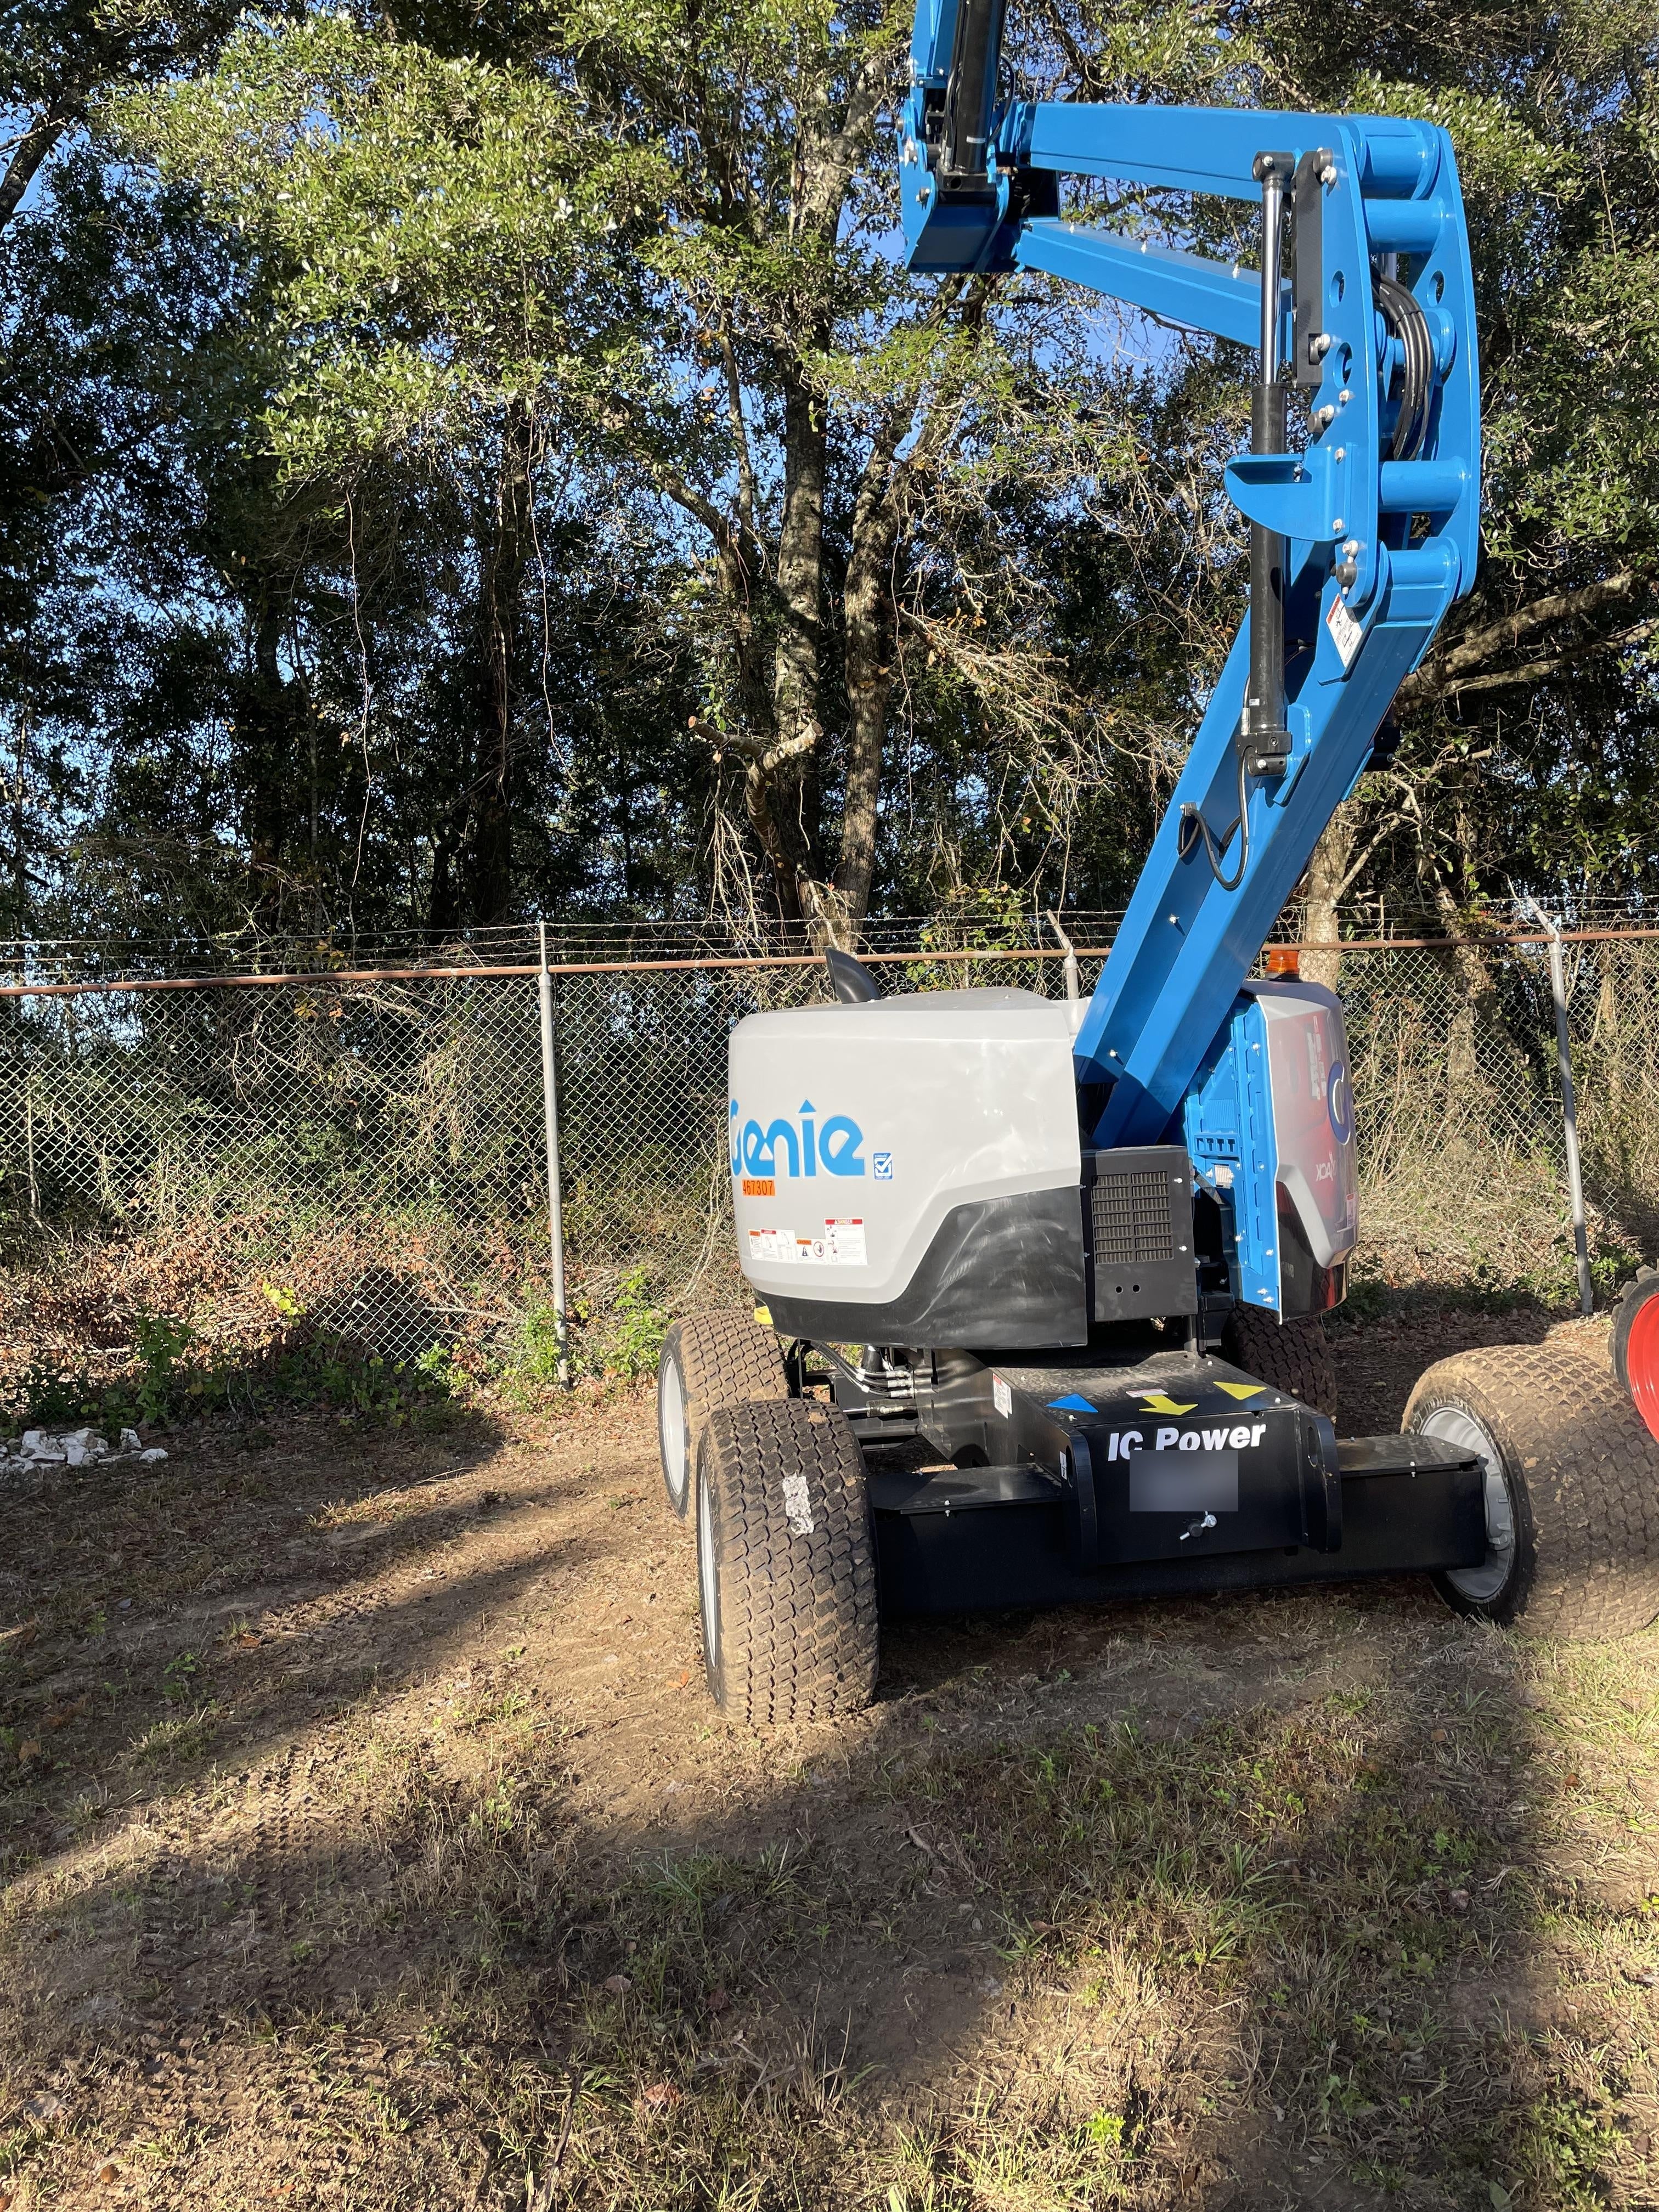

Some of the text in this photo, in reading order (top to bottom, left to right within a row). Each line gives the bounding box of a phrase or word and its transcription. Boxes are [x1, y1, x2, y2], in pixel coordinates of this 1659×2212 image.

[743, 1180, 773, 1195] 467307
[1108, 1424, 1267, 1462] IC Power
